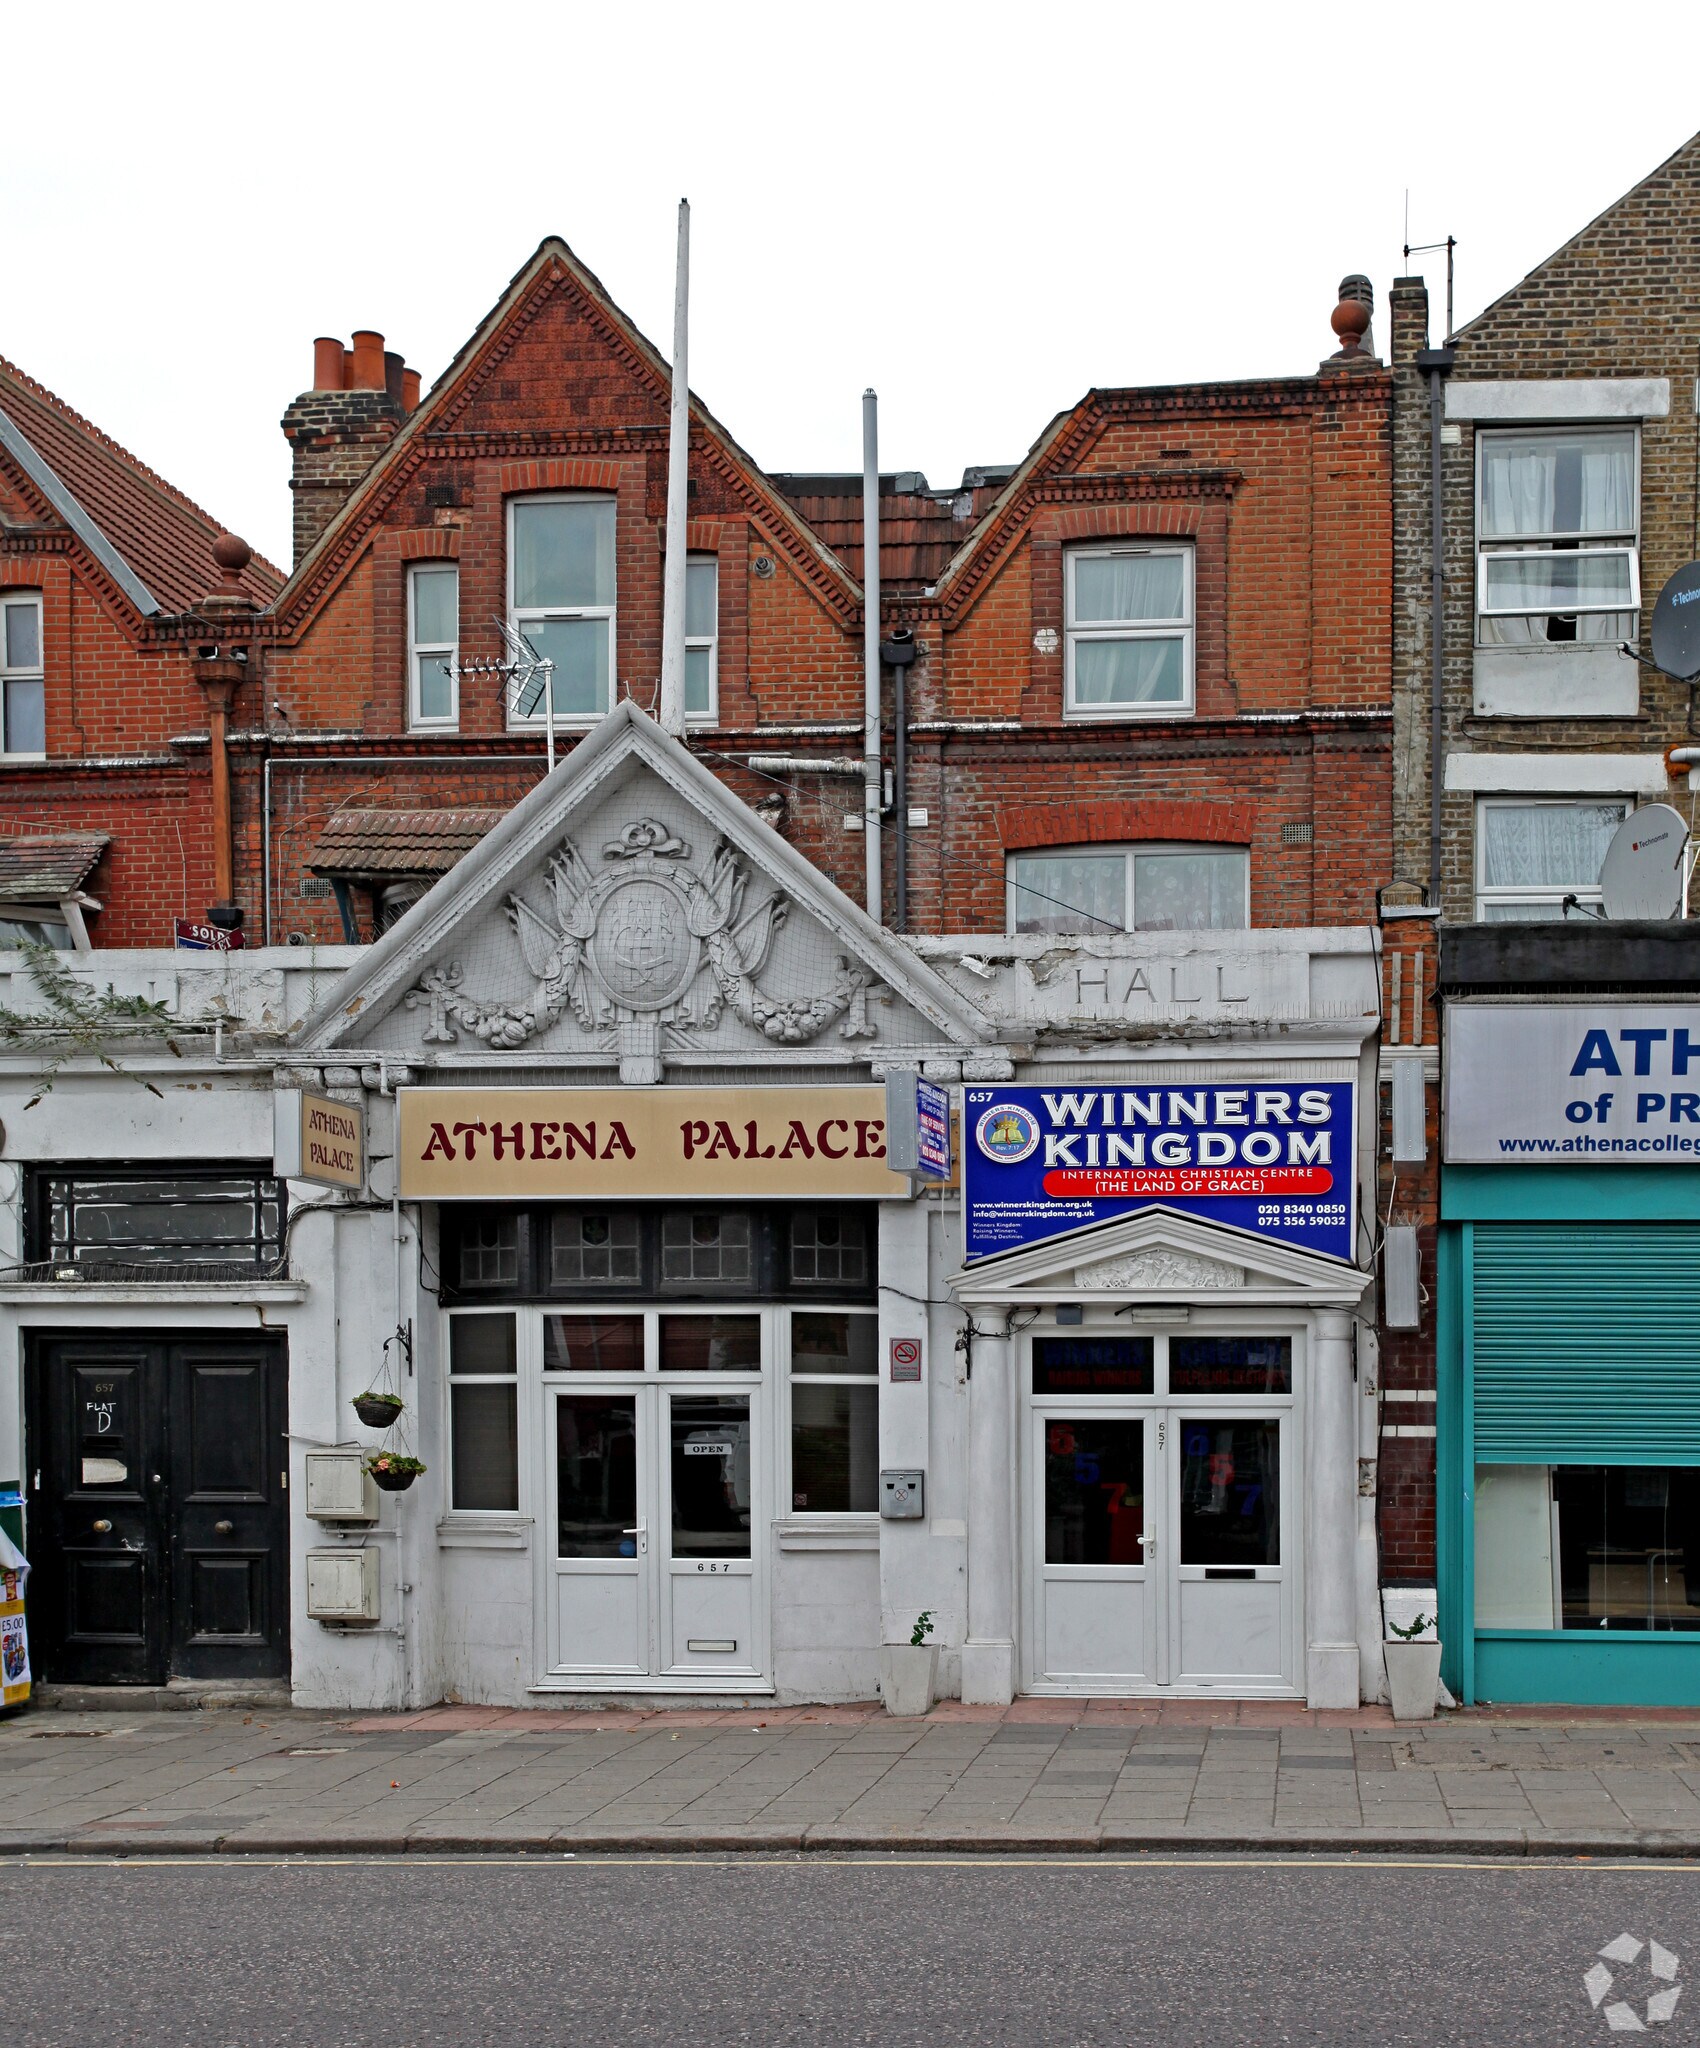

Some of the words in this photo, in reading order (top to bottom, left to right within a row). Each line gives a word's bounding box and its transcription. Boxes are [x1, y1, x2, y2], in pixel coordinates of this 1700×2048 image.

[1075, 966, 1249, 1003] HALL
[969, 1092, 993, 1102] 657
[1041, 1090, 1332, 1126] WINNERS
[1565, 1093, 1613, 1123] of
[1637, 1093, 1700, 1123] PR
[309, 1109, 355, 1140] ATHENA
[420, 1121, 636, 1161] ATHENA
[680, 1120, 887, 1160] PALACE
[310, 1142, 354, 1171] PALACE
[1043, 1131, 1332, 1167] KINGDOM
[1062, 1170, 1175, 1180] INTERNATIONAL
[1180, 1169, 1254, 1178] CHRISTIAN
[1260, 1168, 1313, 1178] CENTRE
[1095, 1181, 1128, 1195] (THE
[1134, 1181, 1175, 1192] LAND
[1182, 1181, 1203, 1191] OF
[1208, 1179, 1265, 1192] GRACE)
[973, 1201, 1092, 1210] www.winnerskingdom.org.uk
[1258, 1205, 1280, 1214] 020
[1284, 1205, 1313, 1213] 8340
[1316, 1204, 1345, 1213] 0850
[973, 1210, 1095, 1219] info@winnerskingdom.org.uk
[1258, 1217, 1280, 1226] 075
[1284, 1217, 1305, 1226] 356
[1309, 1217, 1345, 1225] 59032
[95, 1384, 114, 1393] 657
[86, 1402, 116, 1413] FLAT
[98, 1411, 111, 1433] D
[2, 1617, 24, 1632] £5.00
